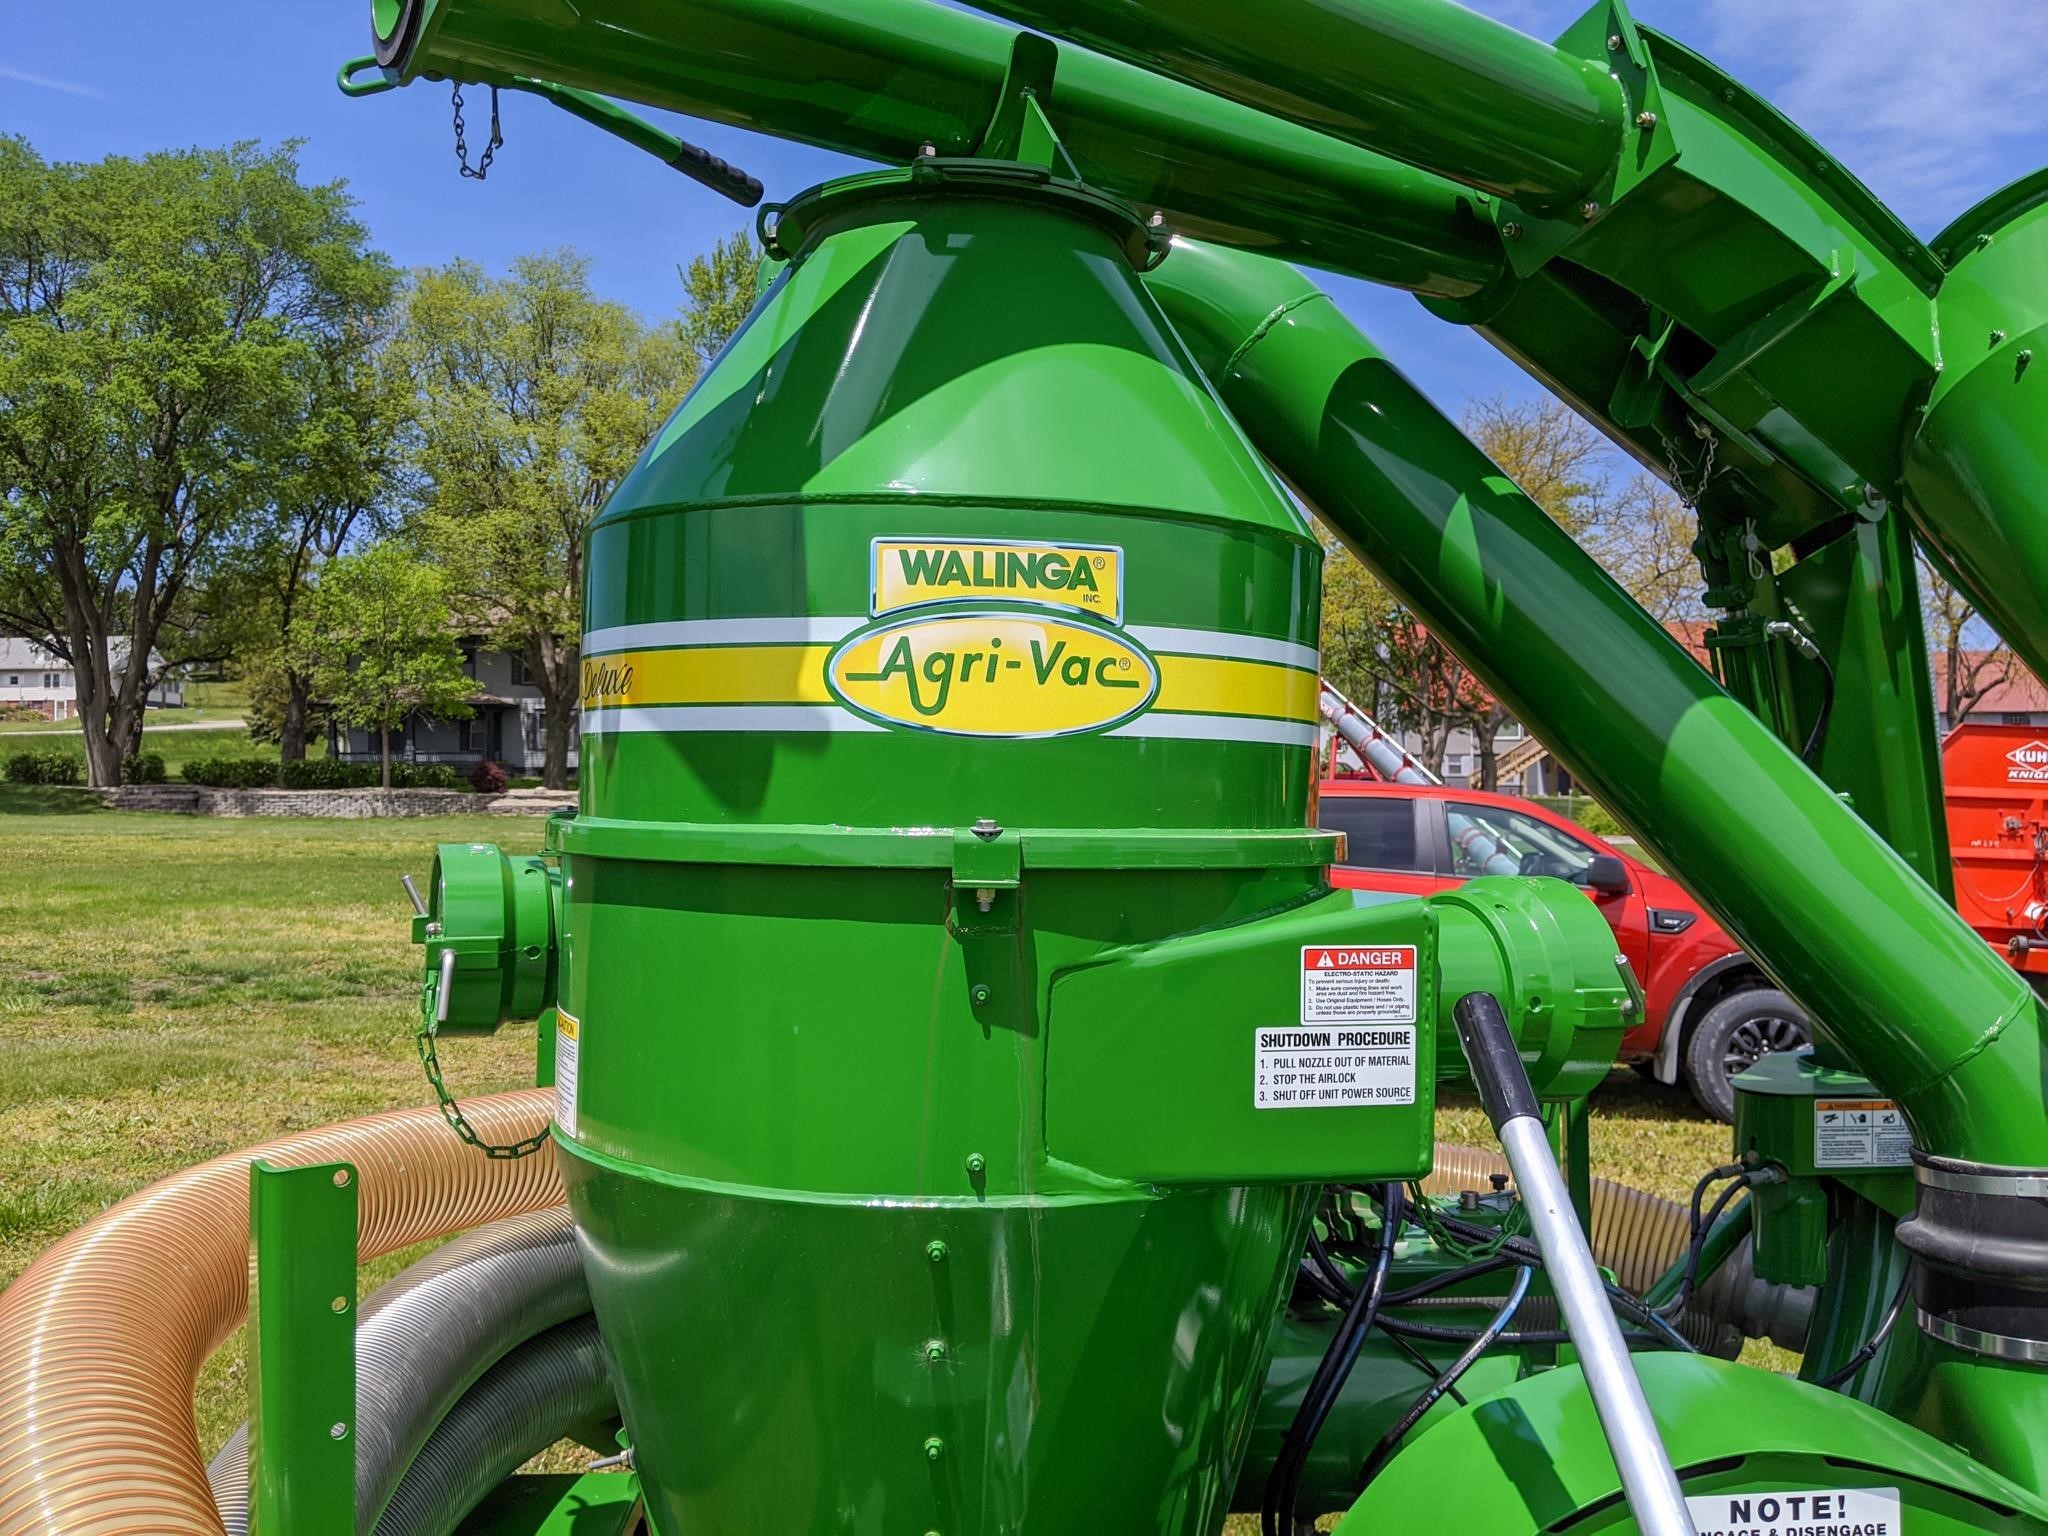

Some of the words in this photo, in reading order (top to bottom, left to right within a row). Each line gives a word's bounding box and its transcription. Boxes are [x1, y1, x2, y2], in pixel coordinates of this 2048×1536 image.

[898, 549, 1099, 592] WALINGA
[582, 661, 634, 701] Deluxe
[845, 635, 1140, 716] Agri-Vac
[2015, 750, 2048, 763] KUH
[1337, 951, 1402, 965] DANGER
[1260, 1033, 1331, 1048] SHUTDOWN
[1338, 1031, 1411, 1046] PROCEDURE
[1273, 1058, 1296, 1068] PULL
[1298, 1057, 1332, 1068] NOZZLE
[1334, 1056, 1352, 1068] OUT
[1354, 1056, 1366, 1067] OF
[1368, 1056, 1411, 1066] MATERIAL
[1273, 1074, 1297, 1085] STOP
[1298, 1074, 1316, 1084] THE
[1318, 1072, 1356, 1084] AIRLOCK
[1273, 1090, 1298, 1101] SHUT
[1299, 1090, 1316, 1100] OFF
[1318, 1088, 1340, 1100] UNIT
[1341, 1088, 1374, 1099] POWER
[1375, 1087, 1411, 1098] SOURCE
[1730, 1495, 1846, 1524] NOTE!
[1786, 1523, 1886, 1536] DISENGAGE
